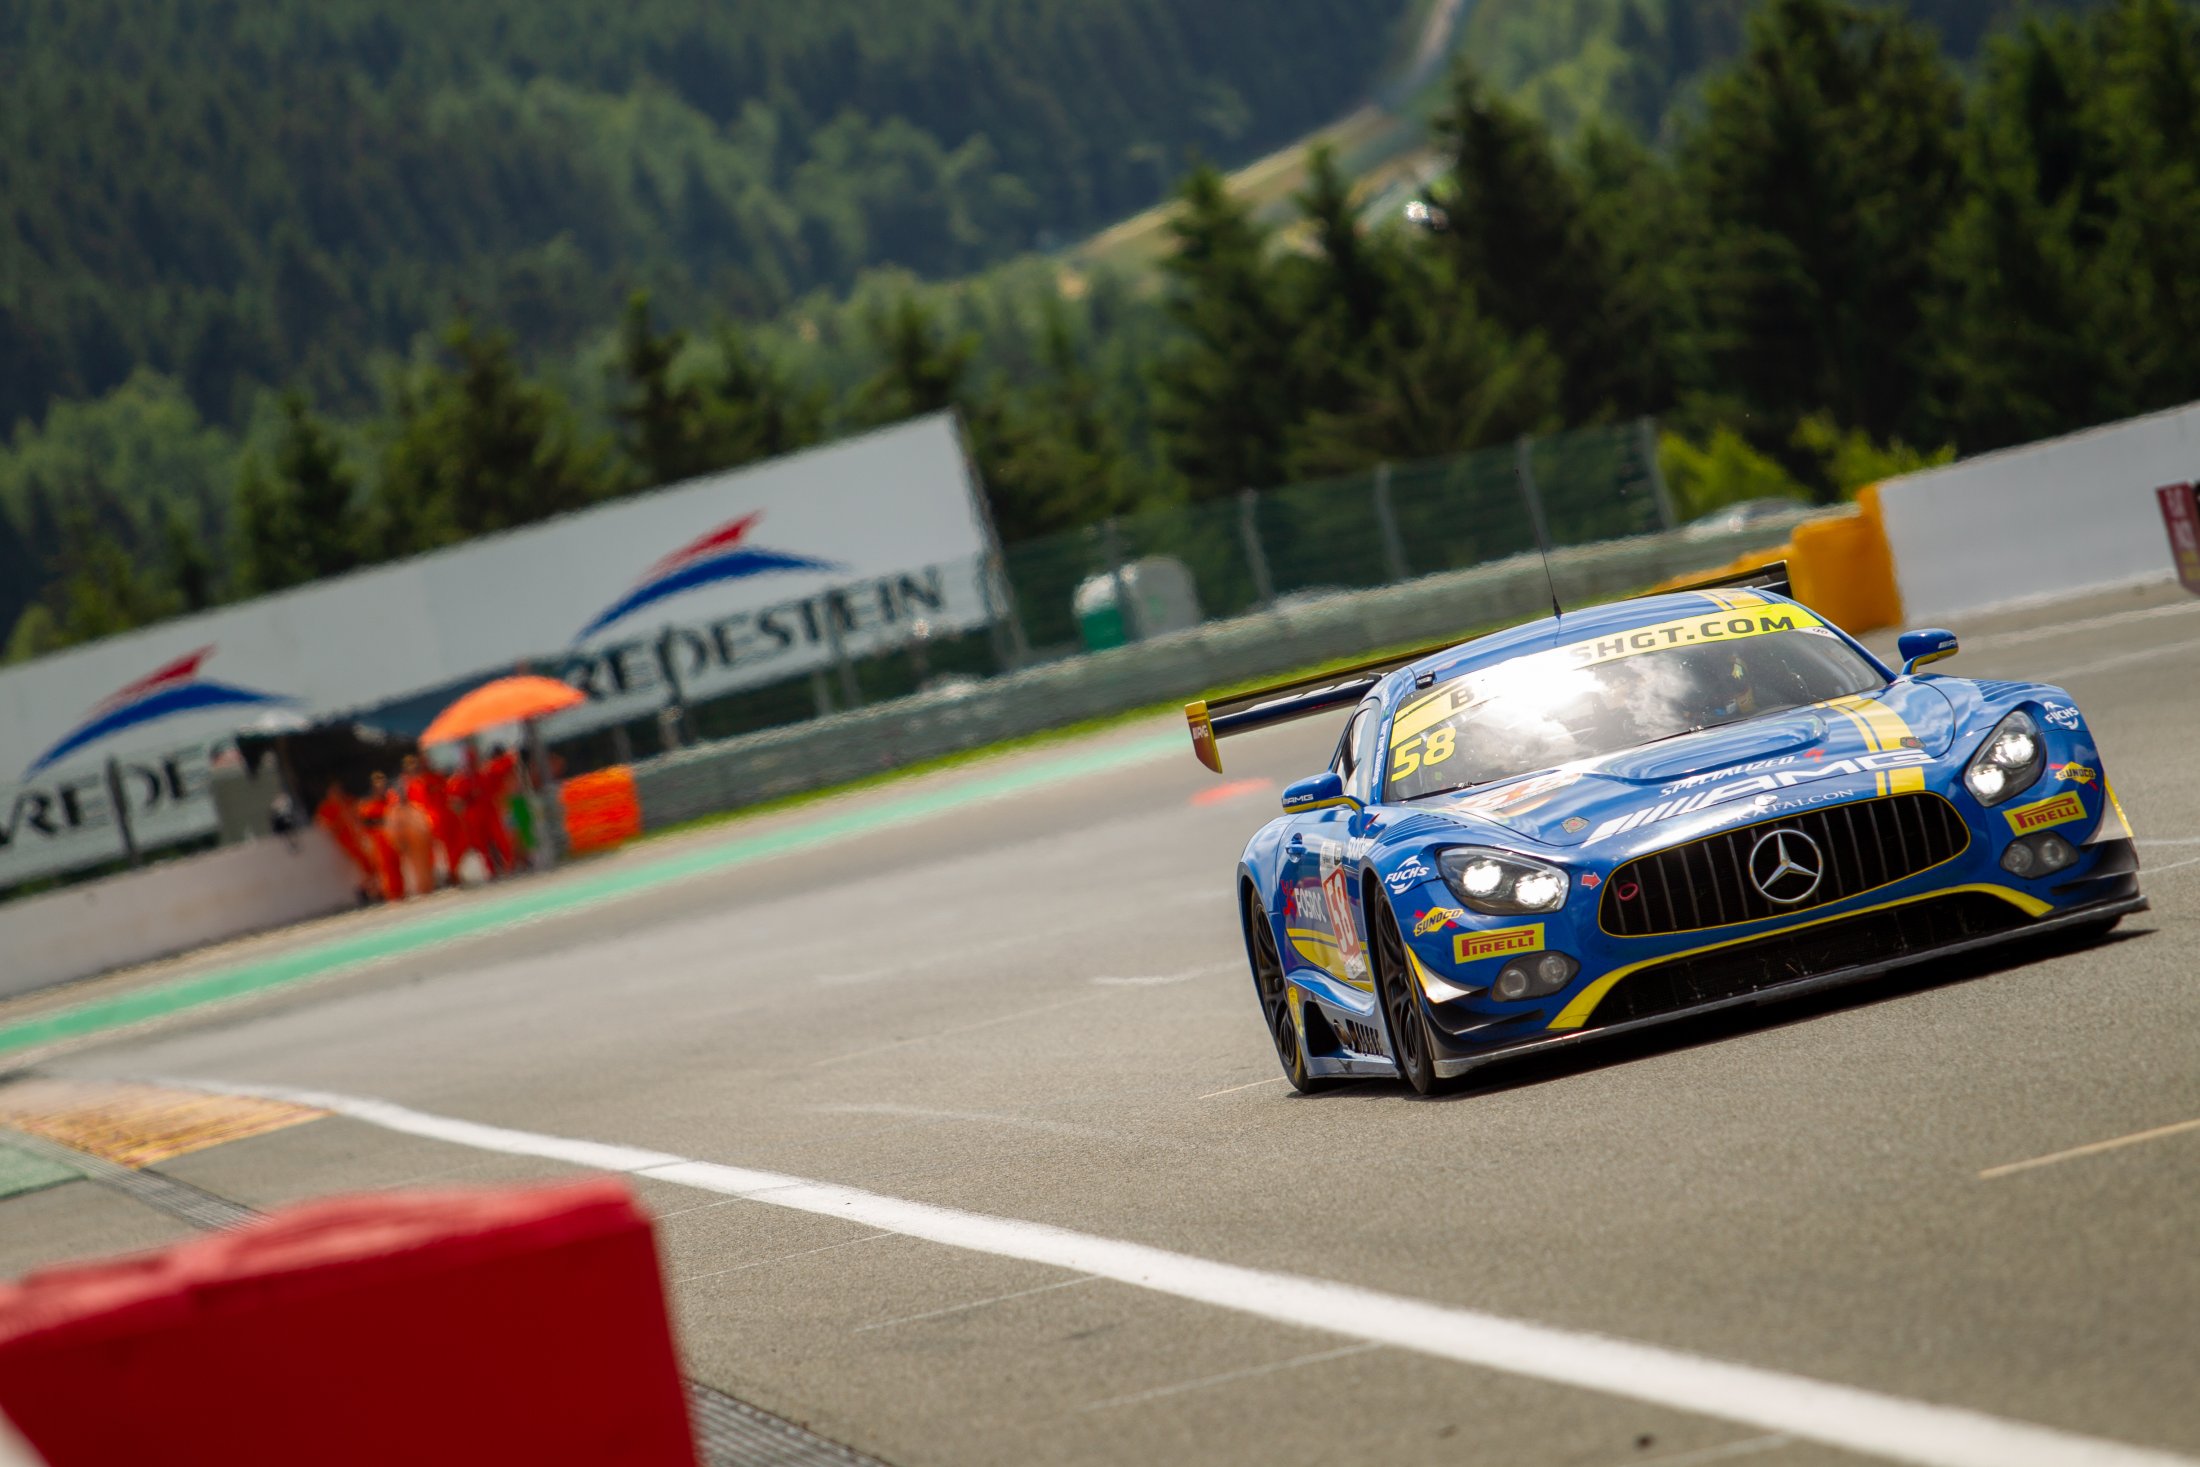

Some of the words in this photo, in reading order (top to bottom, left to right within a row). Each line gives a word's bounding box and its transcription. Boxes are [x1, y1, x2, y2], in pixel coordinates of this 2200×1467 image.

[552, 563, 944, 702] REDESTEIN
[2044, 706, 2080, 723] FUCHS
[1391, 727, 1456, 782] 58
[1659, 755, 1796, 798] SPECIALIZED
[2059, 767, 2095, 779] SUNOCO
[1769, 788, 1855, 813] FALCON
[2013, 798, 2080, 829] PIRELLI
[1384, 866, 1430, 884] FUCHS
[1415, 909, 1462, 936] SUNOCO
[1461, 929, 1535, 957] PIRELLI
